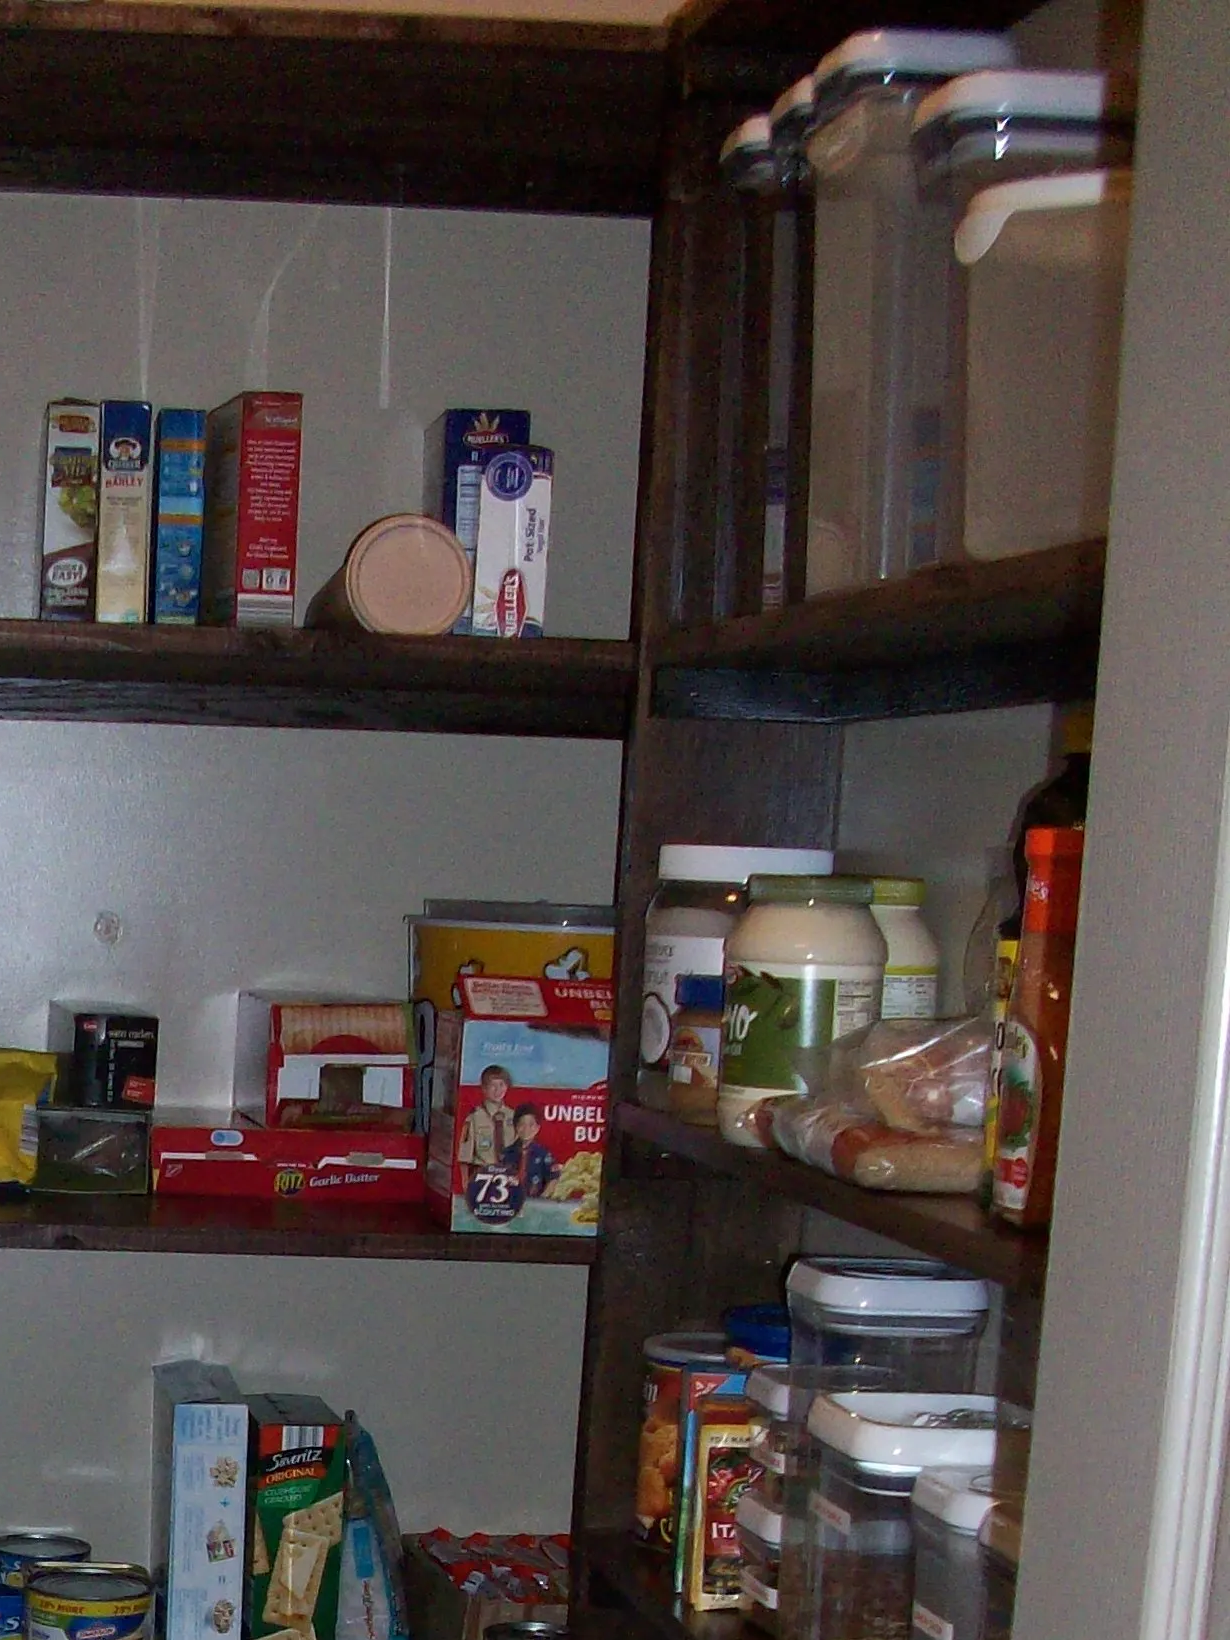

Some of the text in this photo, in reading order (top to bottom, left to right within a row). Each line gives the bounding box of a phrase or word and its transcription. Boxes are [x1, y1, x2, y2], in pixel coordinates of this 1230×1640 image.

[273, 1170, 382, 1191] RITZ Garlic Butter
[265, 1467, 316, 1485] ORIGINAL
